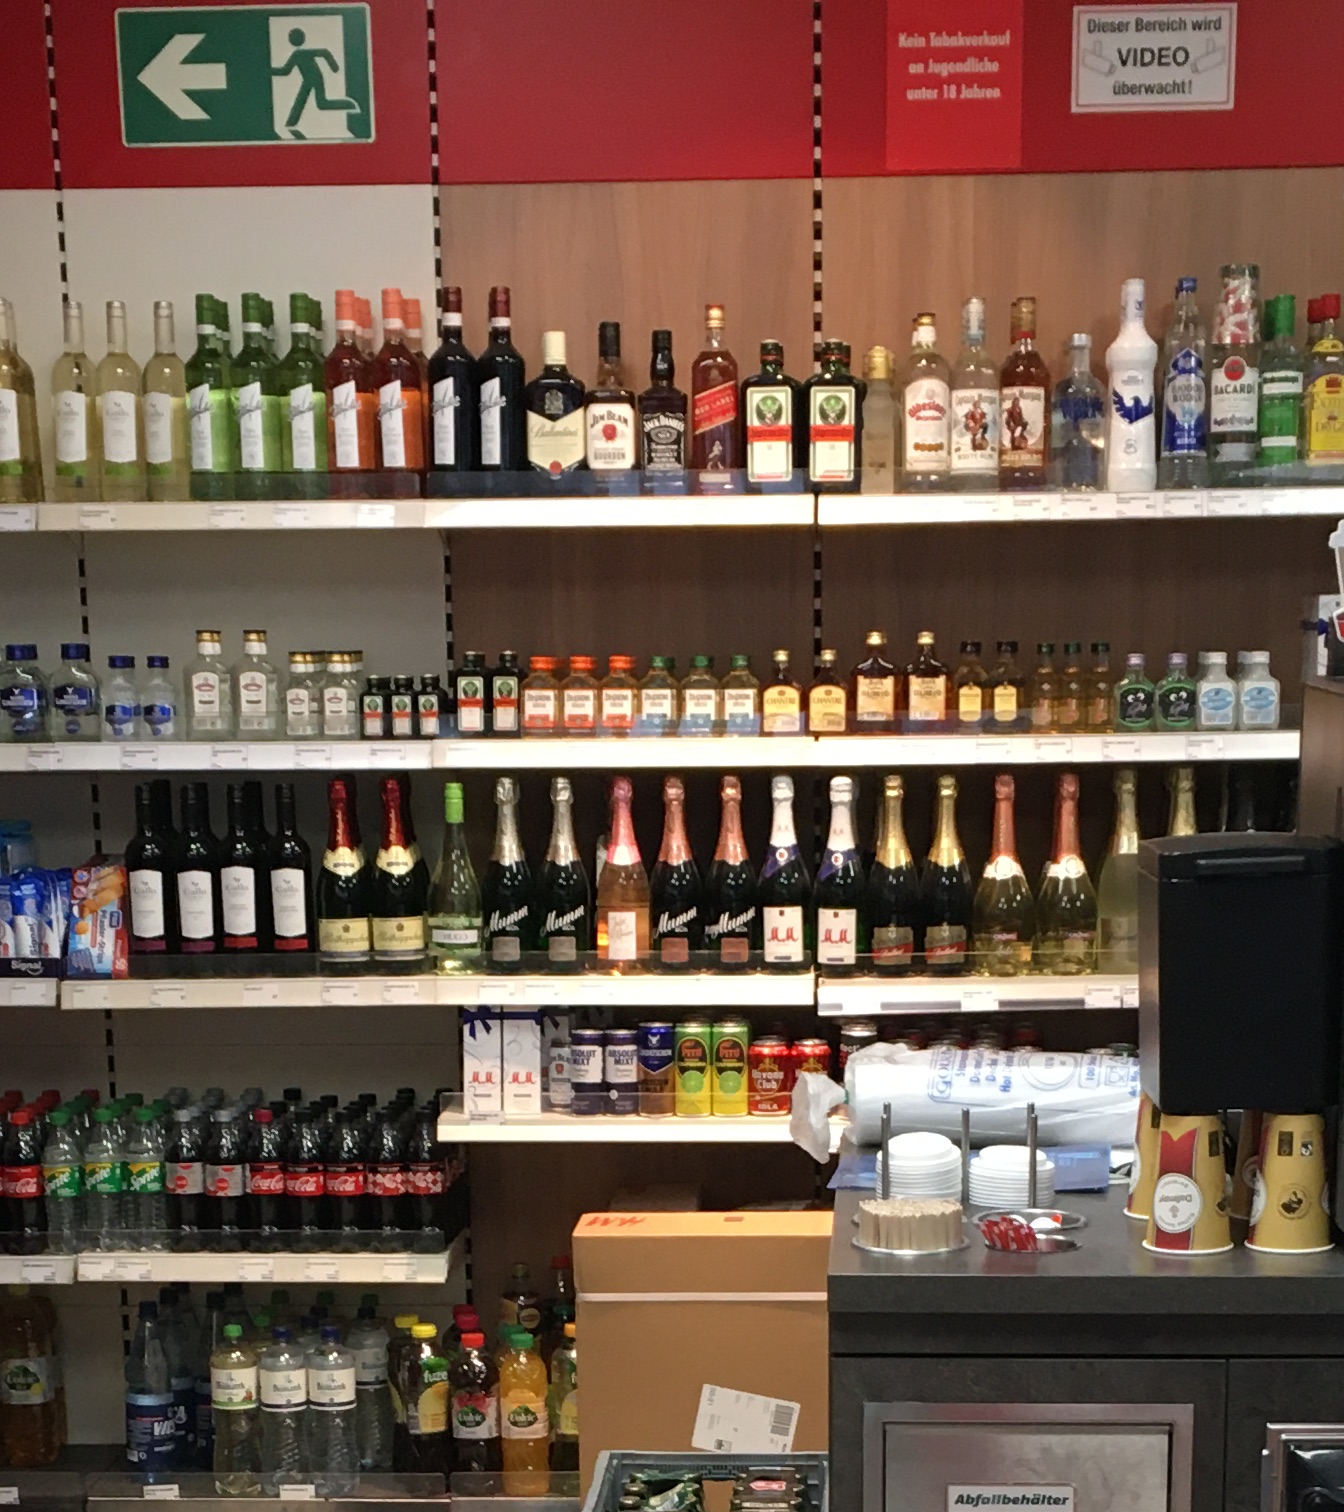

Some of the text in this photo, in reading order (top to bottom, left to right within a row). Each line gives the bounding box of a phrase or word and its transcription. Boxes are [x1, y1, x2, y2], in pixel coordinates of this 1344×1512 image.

[1087, 15, 1222, 34] Dieser Bereich wird
[898, 30, 1011, 48] Kein Tabakverkauf
[1117, 46, 1189, 68] VIDEO
[908, 59, 1000, 77] an Jugendliche
[906, 84, 1001, 100] unter 18 Jahren
[1113, 80, 1193, 97] überwacht!
[485, 905, 529, 935] Mumm
[540, 905, 584, 935] Mumm
[655, 906, 698, 935] Mumm
[714, 906, 756, 935] Mumm
[11, 960, 43, 973] Signal
[752, 1070, 784, 1080] Havana
[756, 1078, 779, 1091] Club
[422, 1369, 449, 1384] fuze
[954, 1490, 1072, 1509] Abfallbehälter
